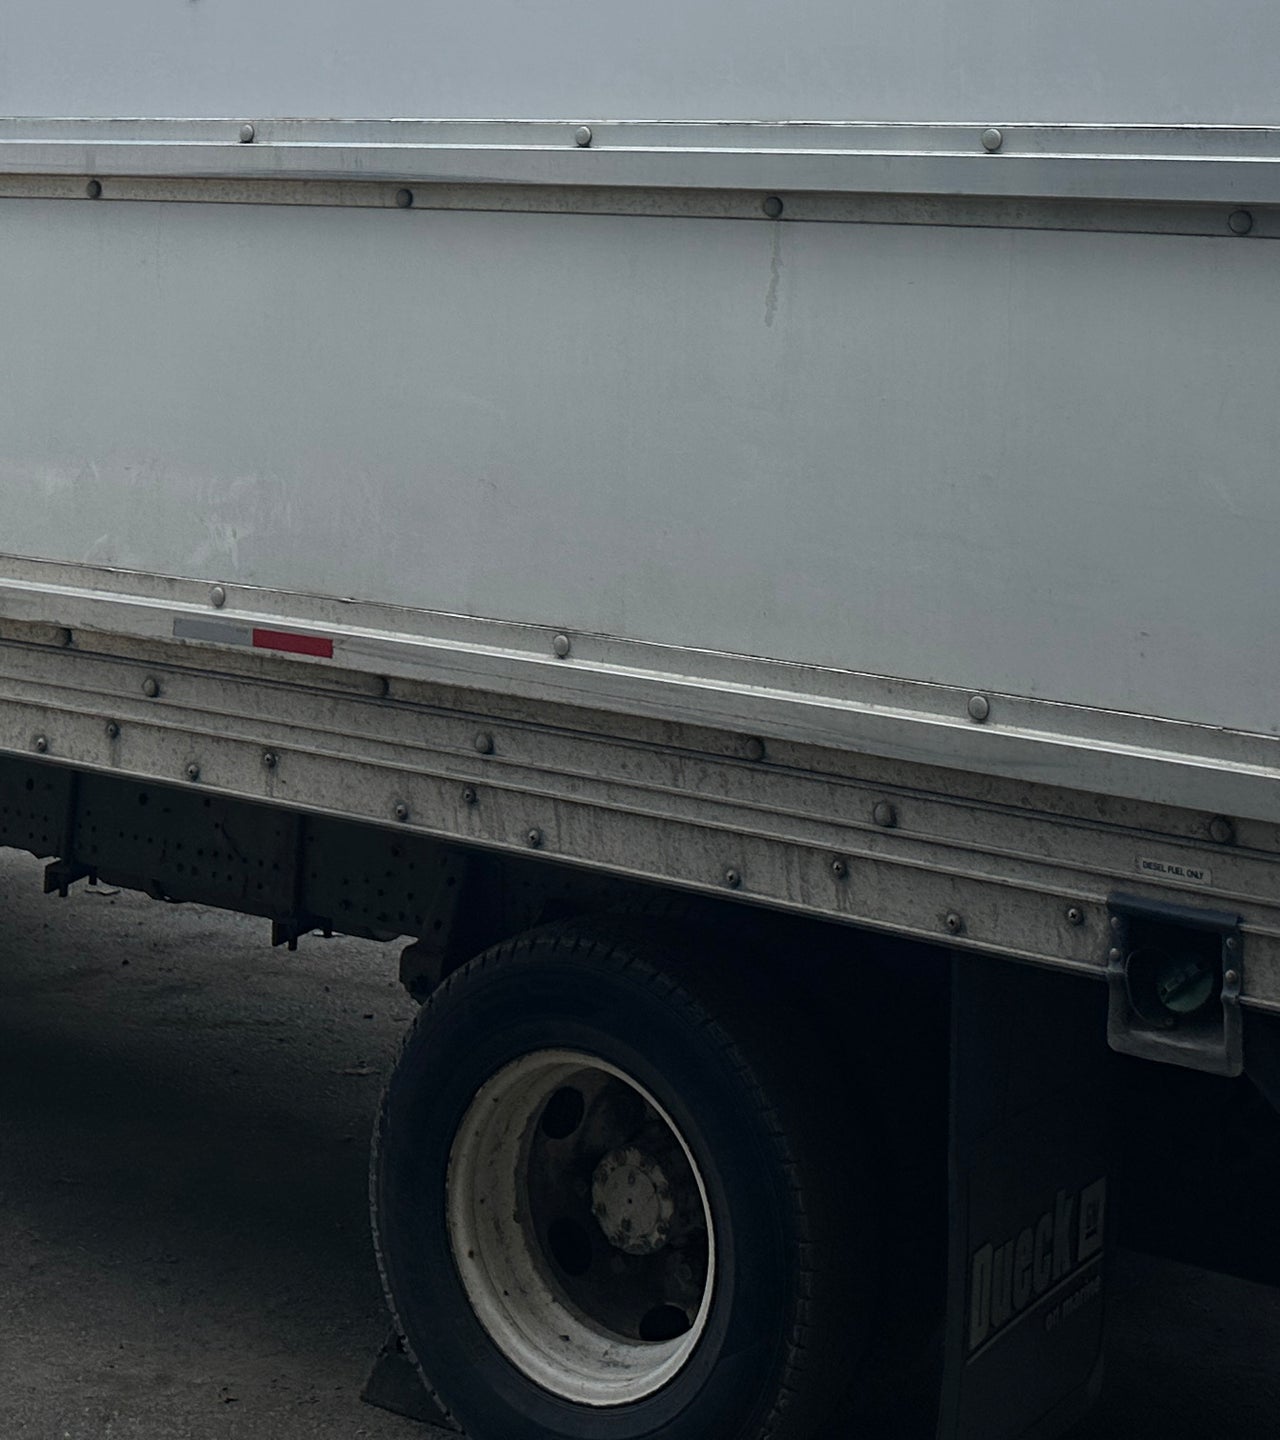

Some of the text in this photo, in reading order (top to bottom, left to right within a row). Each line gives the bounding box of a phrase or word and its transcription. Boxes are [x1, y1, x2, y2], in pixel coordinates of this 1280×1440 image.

[1143, 861, 1204, 879] DIESEL FUEL ONLY
